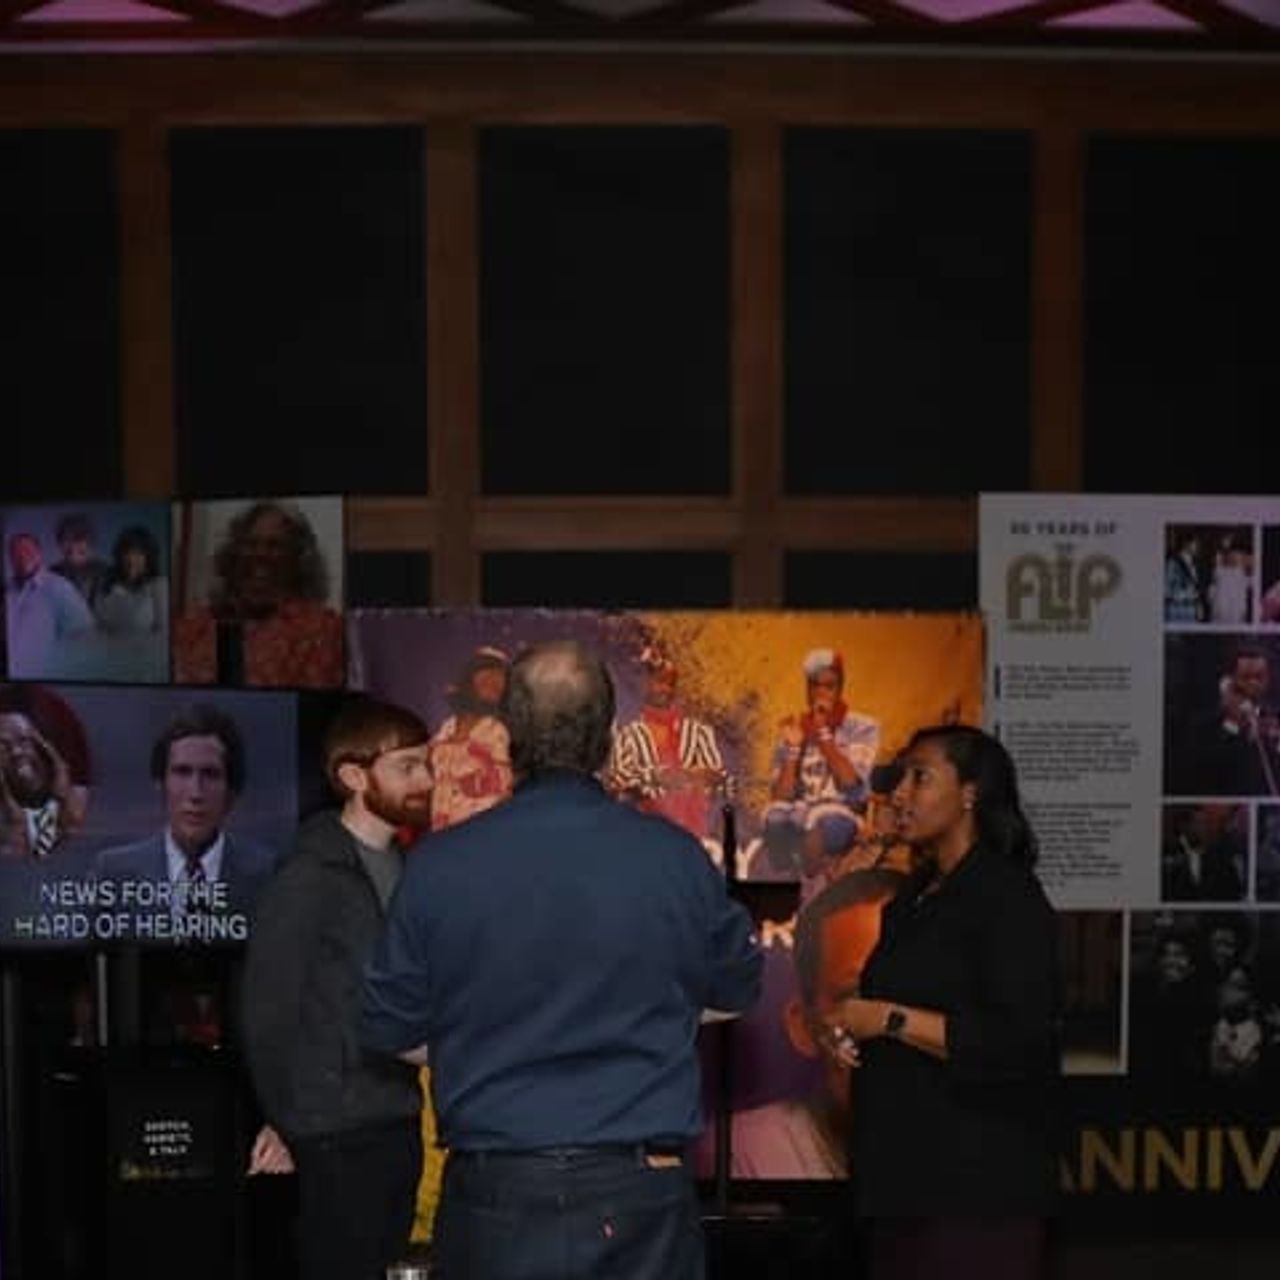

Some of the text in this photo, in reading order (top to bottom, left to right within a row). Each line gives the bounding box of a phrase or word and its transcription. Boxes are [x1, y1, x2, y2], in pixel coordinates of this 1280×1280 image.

[40, 881, 229, 909] NEWS FOR THE
[16, 914, 248, 940] HARD OF HEARING
